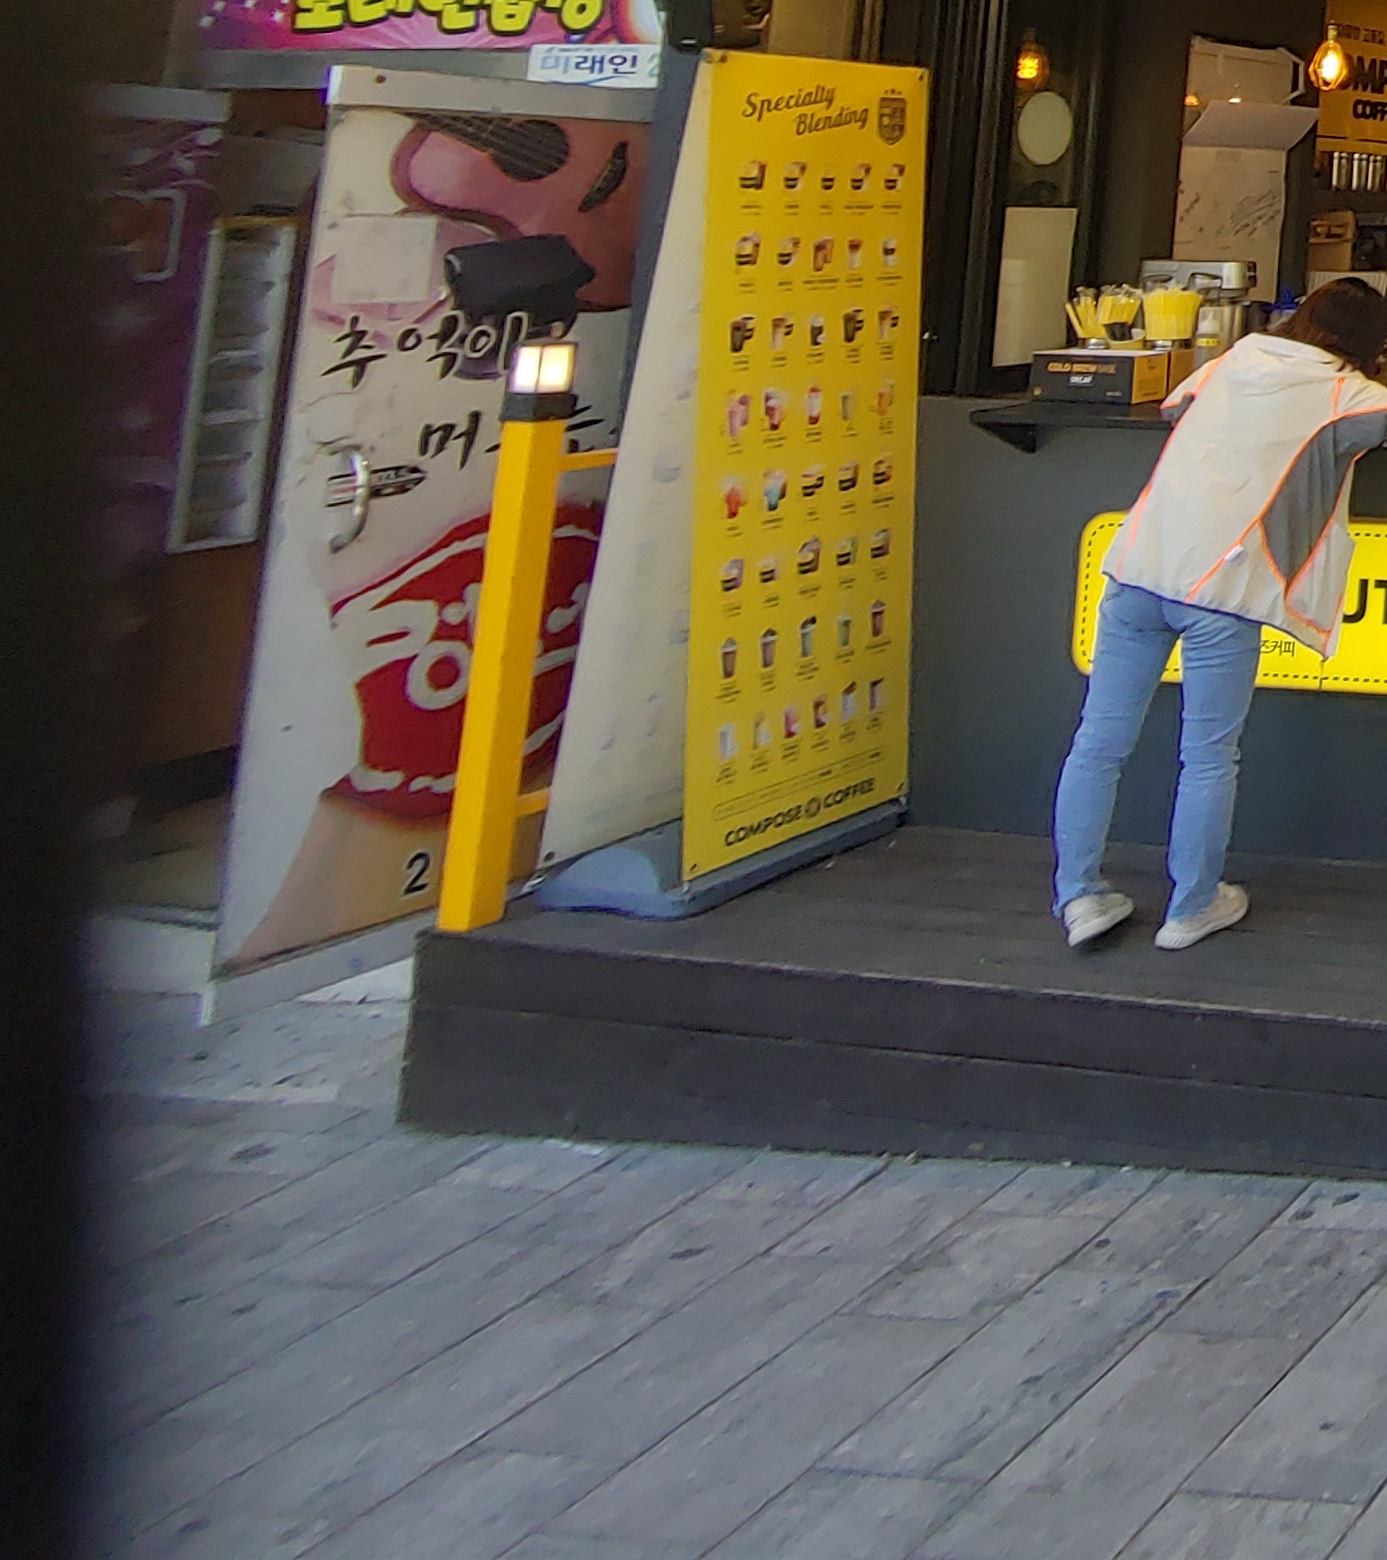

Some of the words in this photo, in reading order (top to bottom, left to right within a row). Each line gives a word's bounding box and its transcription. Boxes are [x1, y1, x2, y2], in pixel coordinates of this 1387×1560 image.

[742, 84, 835, 122] Specialty
[795, 106, 868, 135] Blending
[724, 805, 803, 847] COMPOSE
[823, 777, 875, 808] COFFEE
[403, 852, 431, 895] 2
